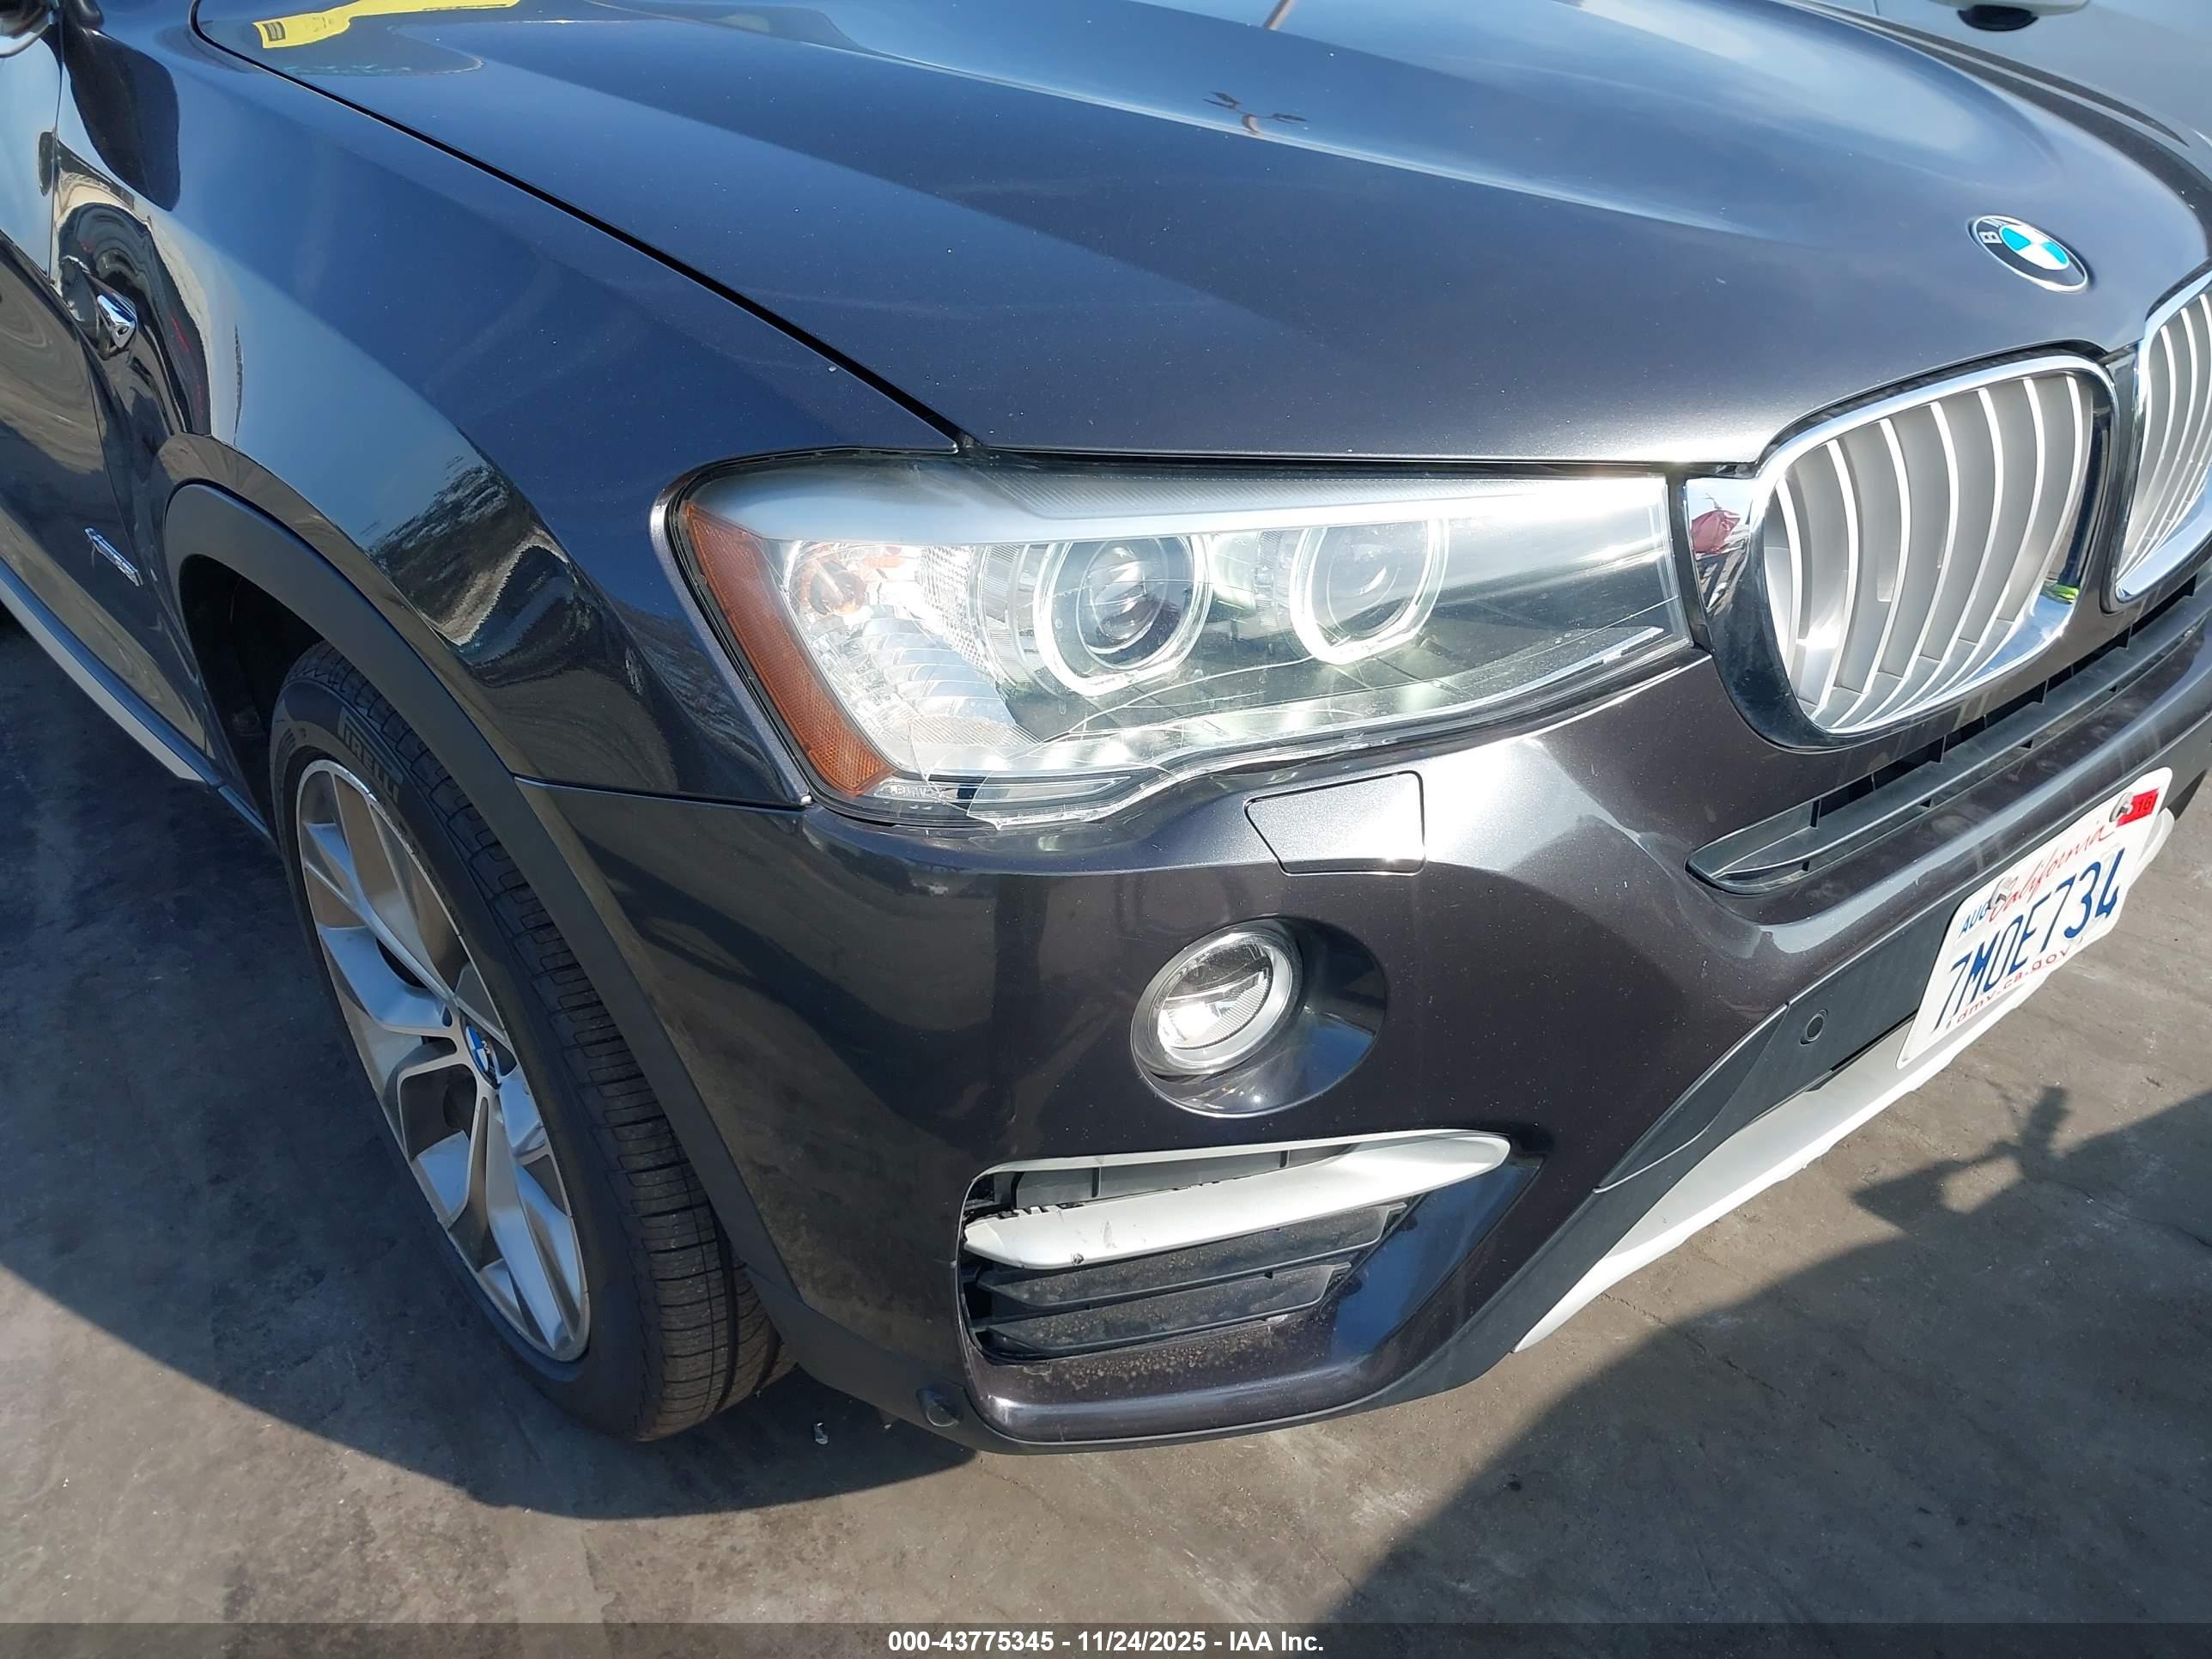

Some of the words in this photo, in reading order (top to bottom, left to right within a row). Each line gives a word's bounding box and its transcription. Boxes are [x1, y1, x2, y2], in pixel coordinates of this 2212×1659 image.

[337, 706, 404, 805] PIRELLI
[1989, 824, 2115, 922] California
[1934, 848, 2125, 1031] 7MOE734
[1956, 946, 2071, 1024] dmv.ca.gov
